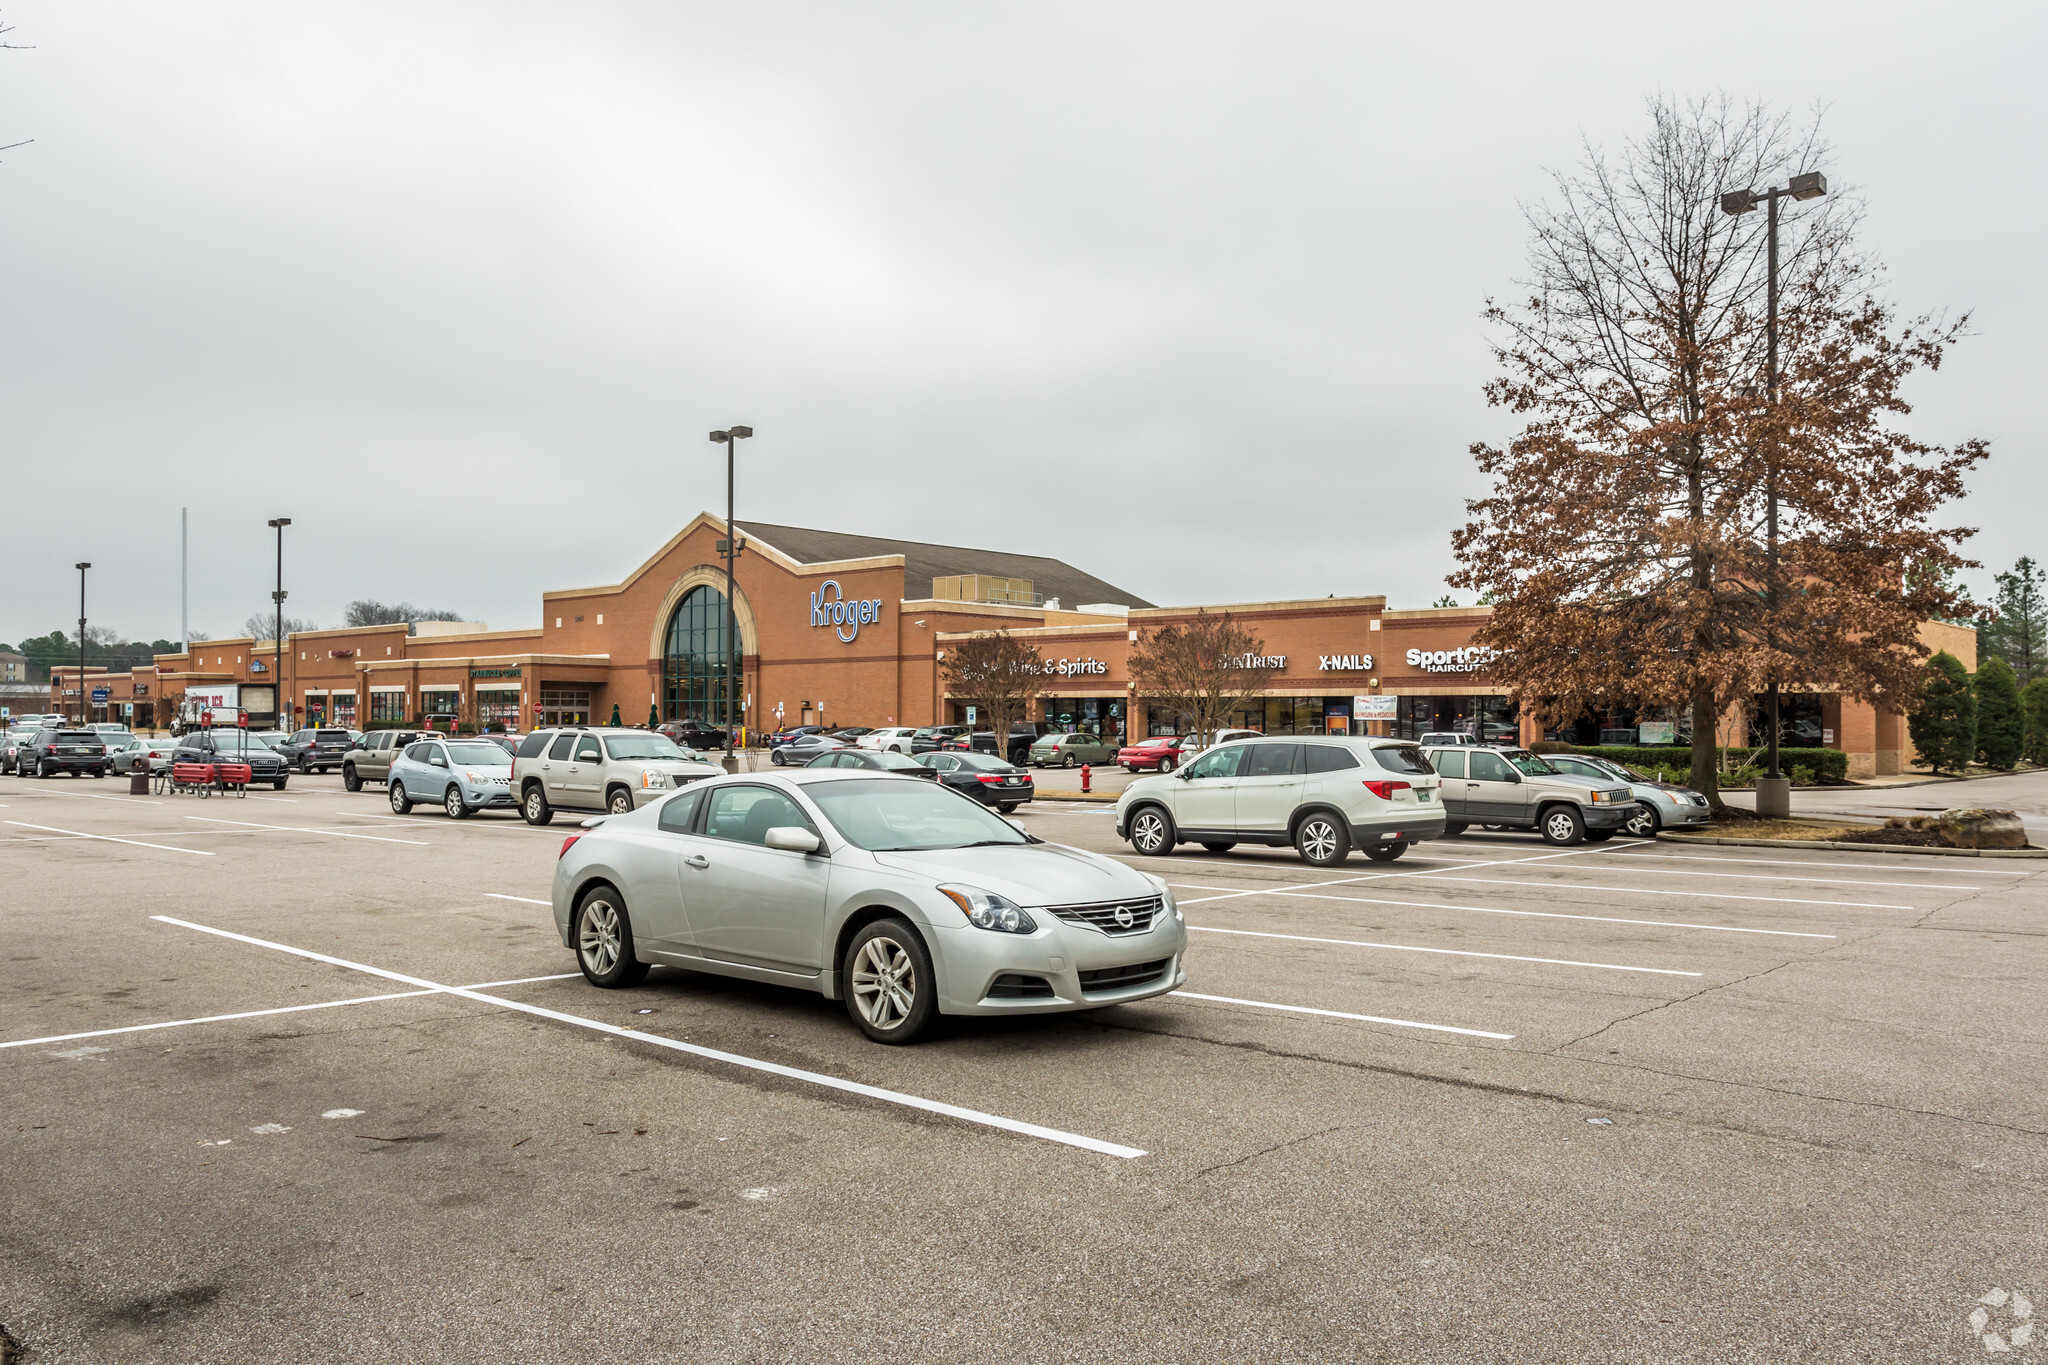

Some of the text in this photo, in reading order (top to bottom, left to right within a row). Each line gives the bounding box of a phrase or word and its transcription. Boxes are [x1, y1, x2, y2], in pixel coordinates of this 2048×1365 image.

[810, 579, 884, 643] Kroger
[1318, 654, 1374, 671] X-NAILS
[1406, 646, 1517, 668] SportClip
[1045, 658, 1057, 674] &
[1058, 657, 1107, 678] Spirits
[1427, 663, 1487, 673] HAIRCUT
[211, 695, 224, 707] ICE
